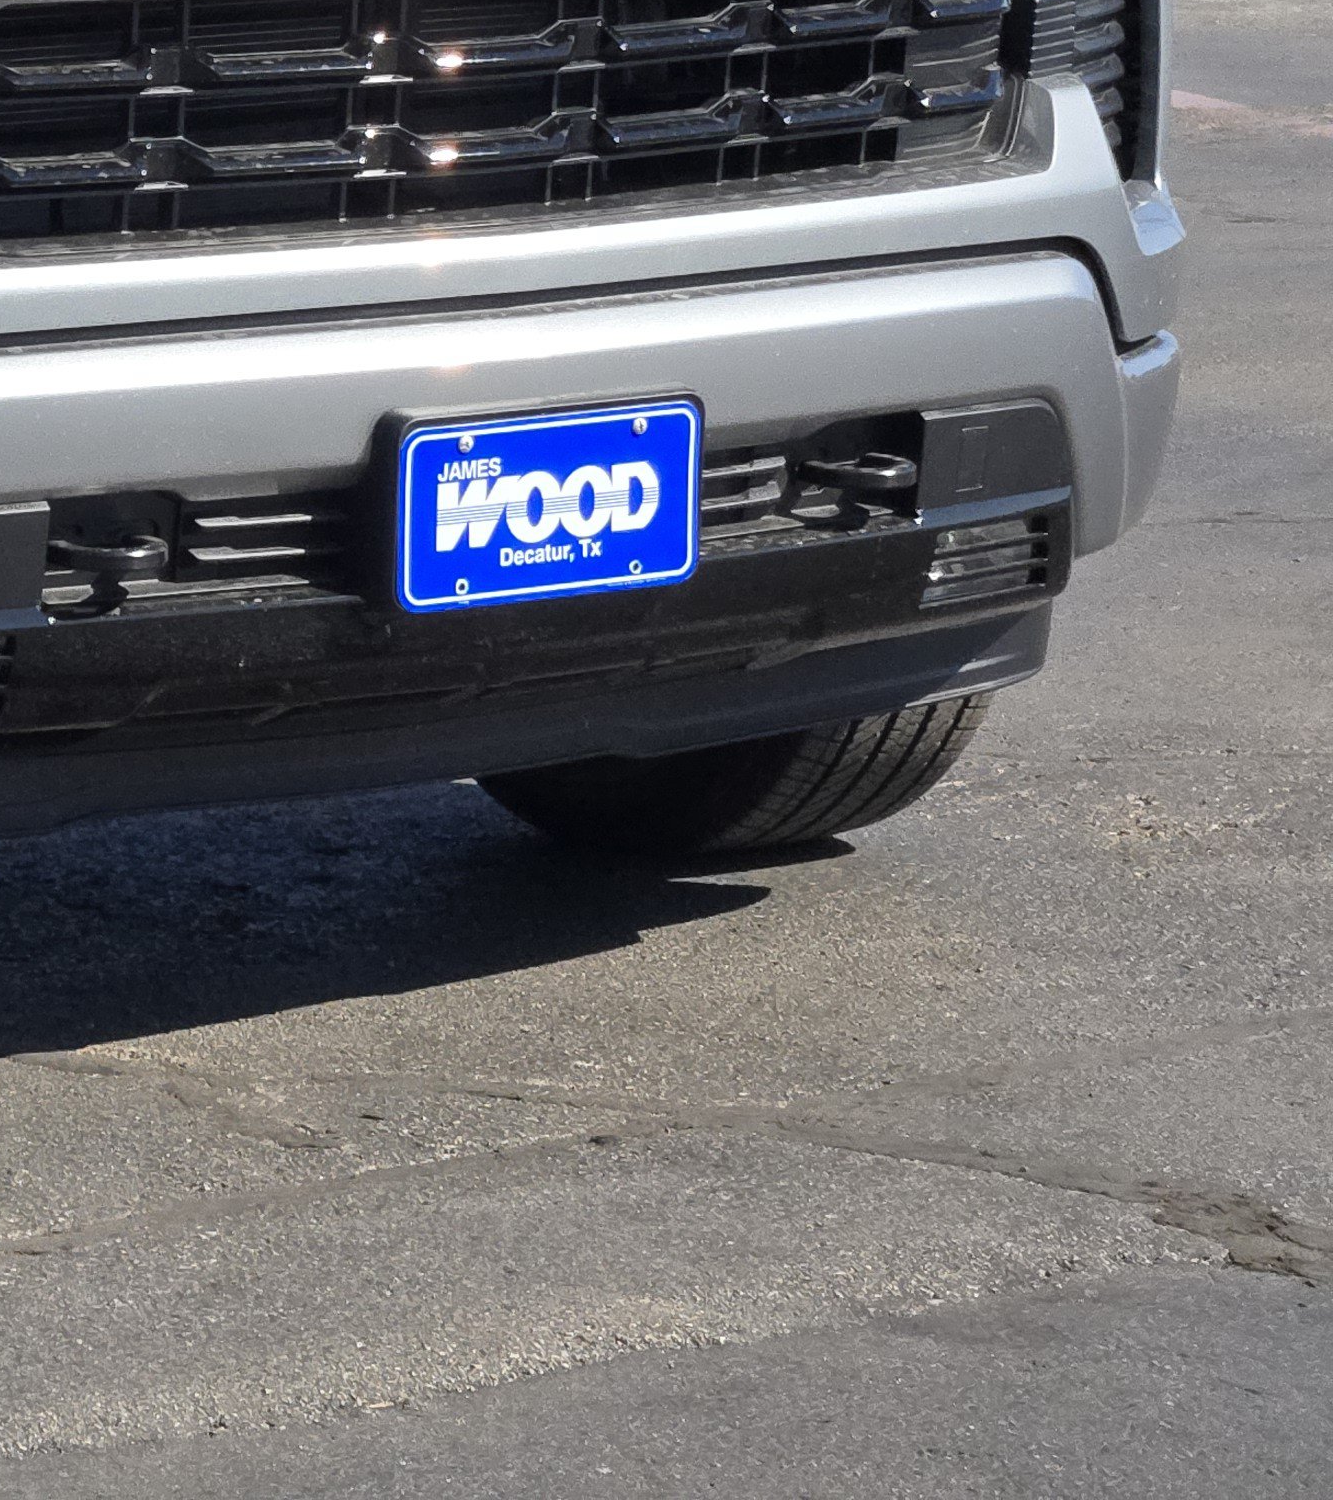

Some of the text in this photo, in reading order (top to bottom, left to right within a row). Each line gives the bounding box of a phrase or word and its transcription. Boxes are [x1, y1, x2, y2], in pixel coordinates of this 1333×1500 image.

[437, 457, 502, 483] JAMES
[435, 460, 660, 552] WOOD
[499, 538, 602, 567] Decatur, Tx
